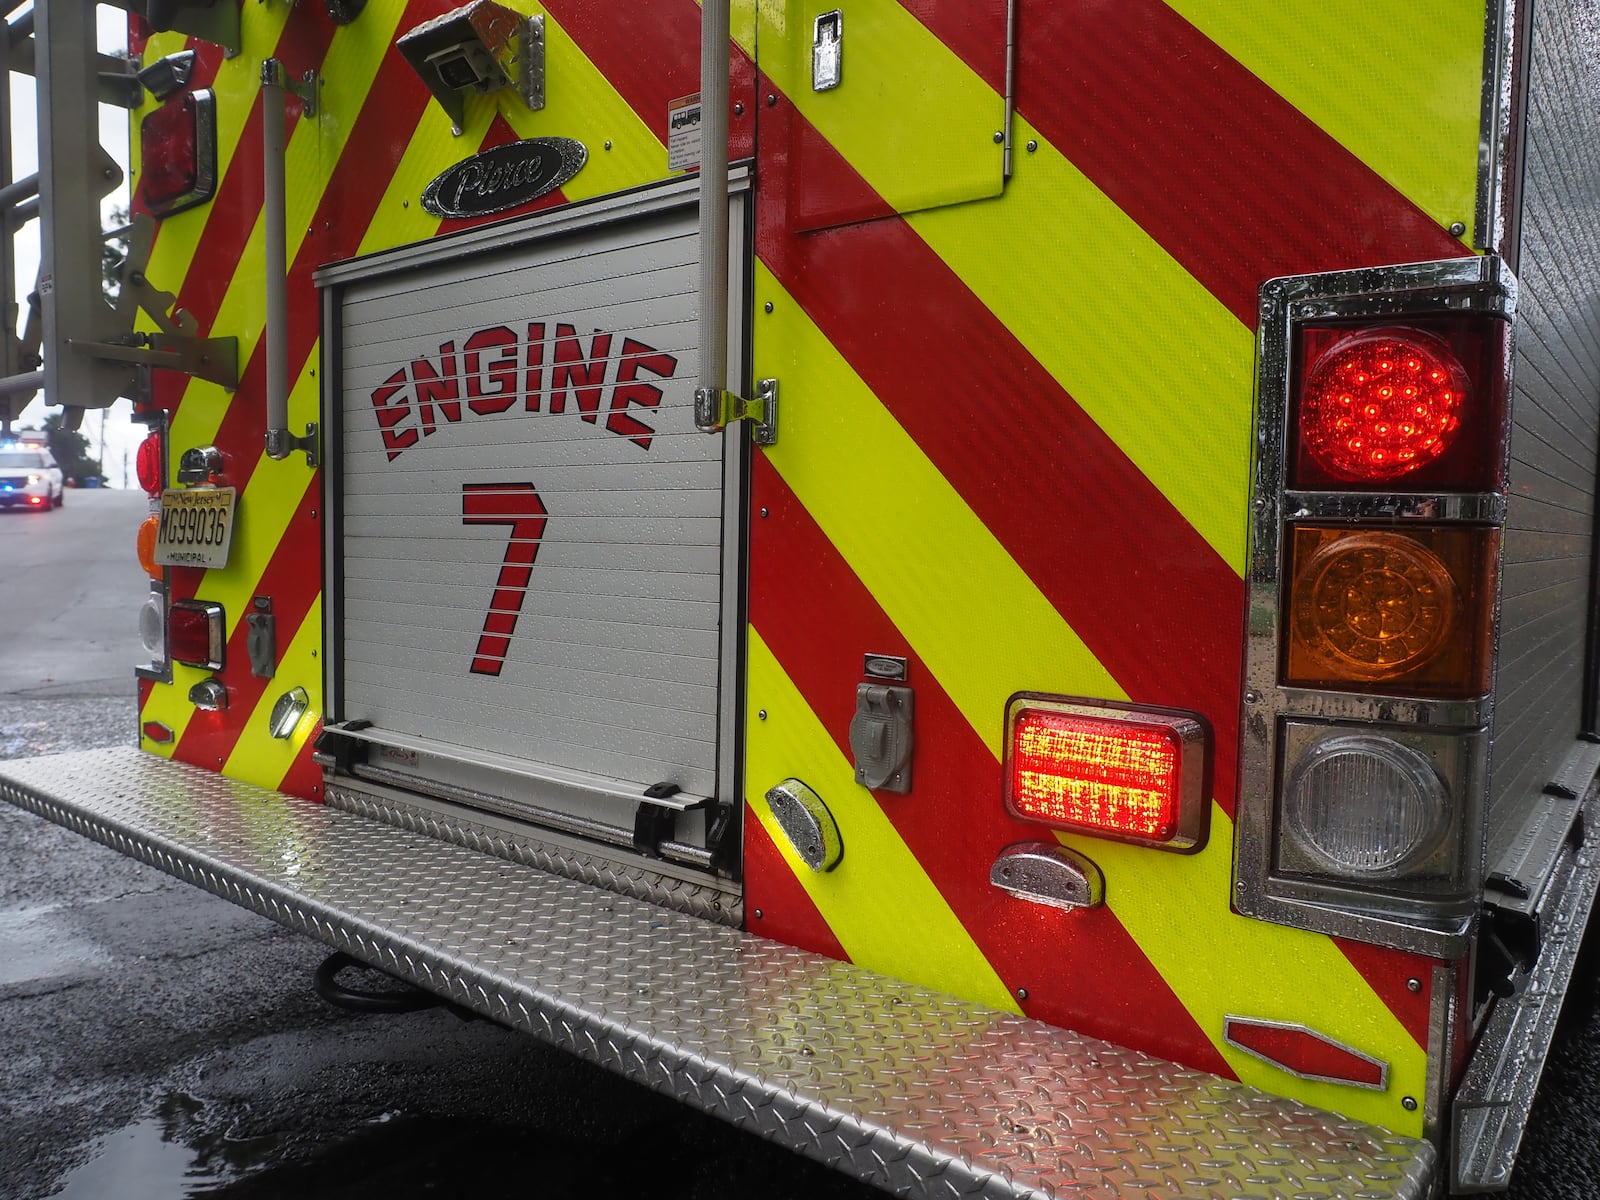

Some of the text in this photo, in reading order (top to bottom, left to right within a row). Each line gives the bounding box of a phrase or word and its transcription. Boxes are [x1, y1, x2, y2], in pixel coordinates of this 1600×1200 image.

[453, 155, 543, 210] Pierce
[371, 322, 678, 462] ENGINE
[178, 491, 214, 507] New Jersey
[158, 507, 227, 546] MG99036
[170, 552, 206, 563] MUNICIPAL
[462, 482, 548, 676] 7
